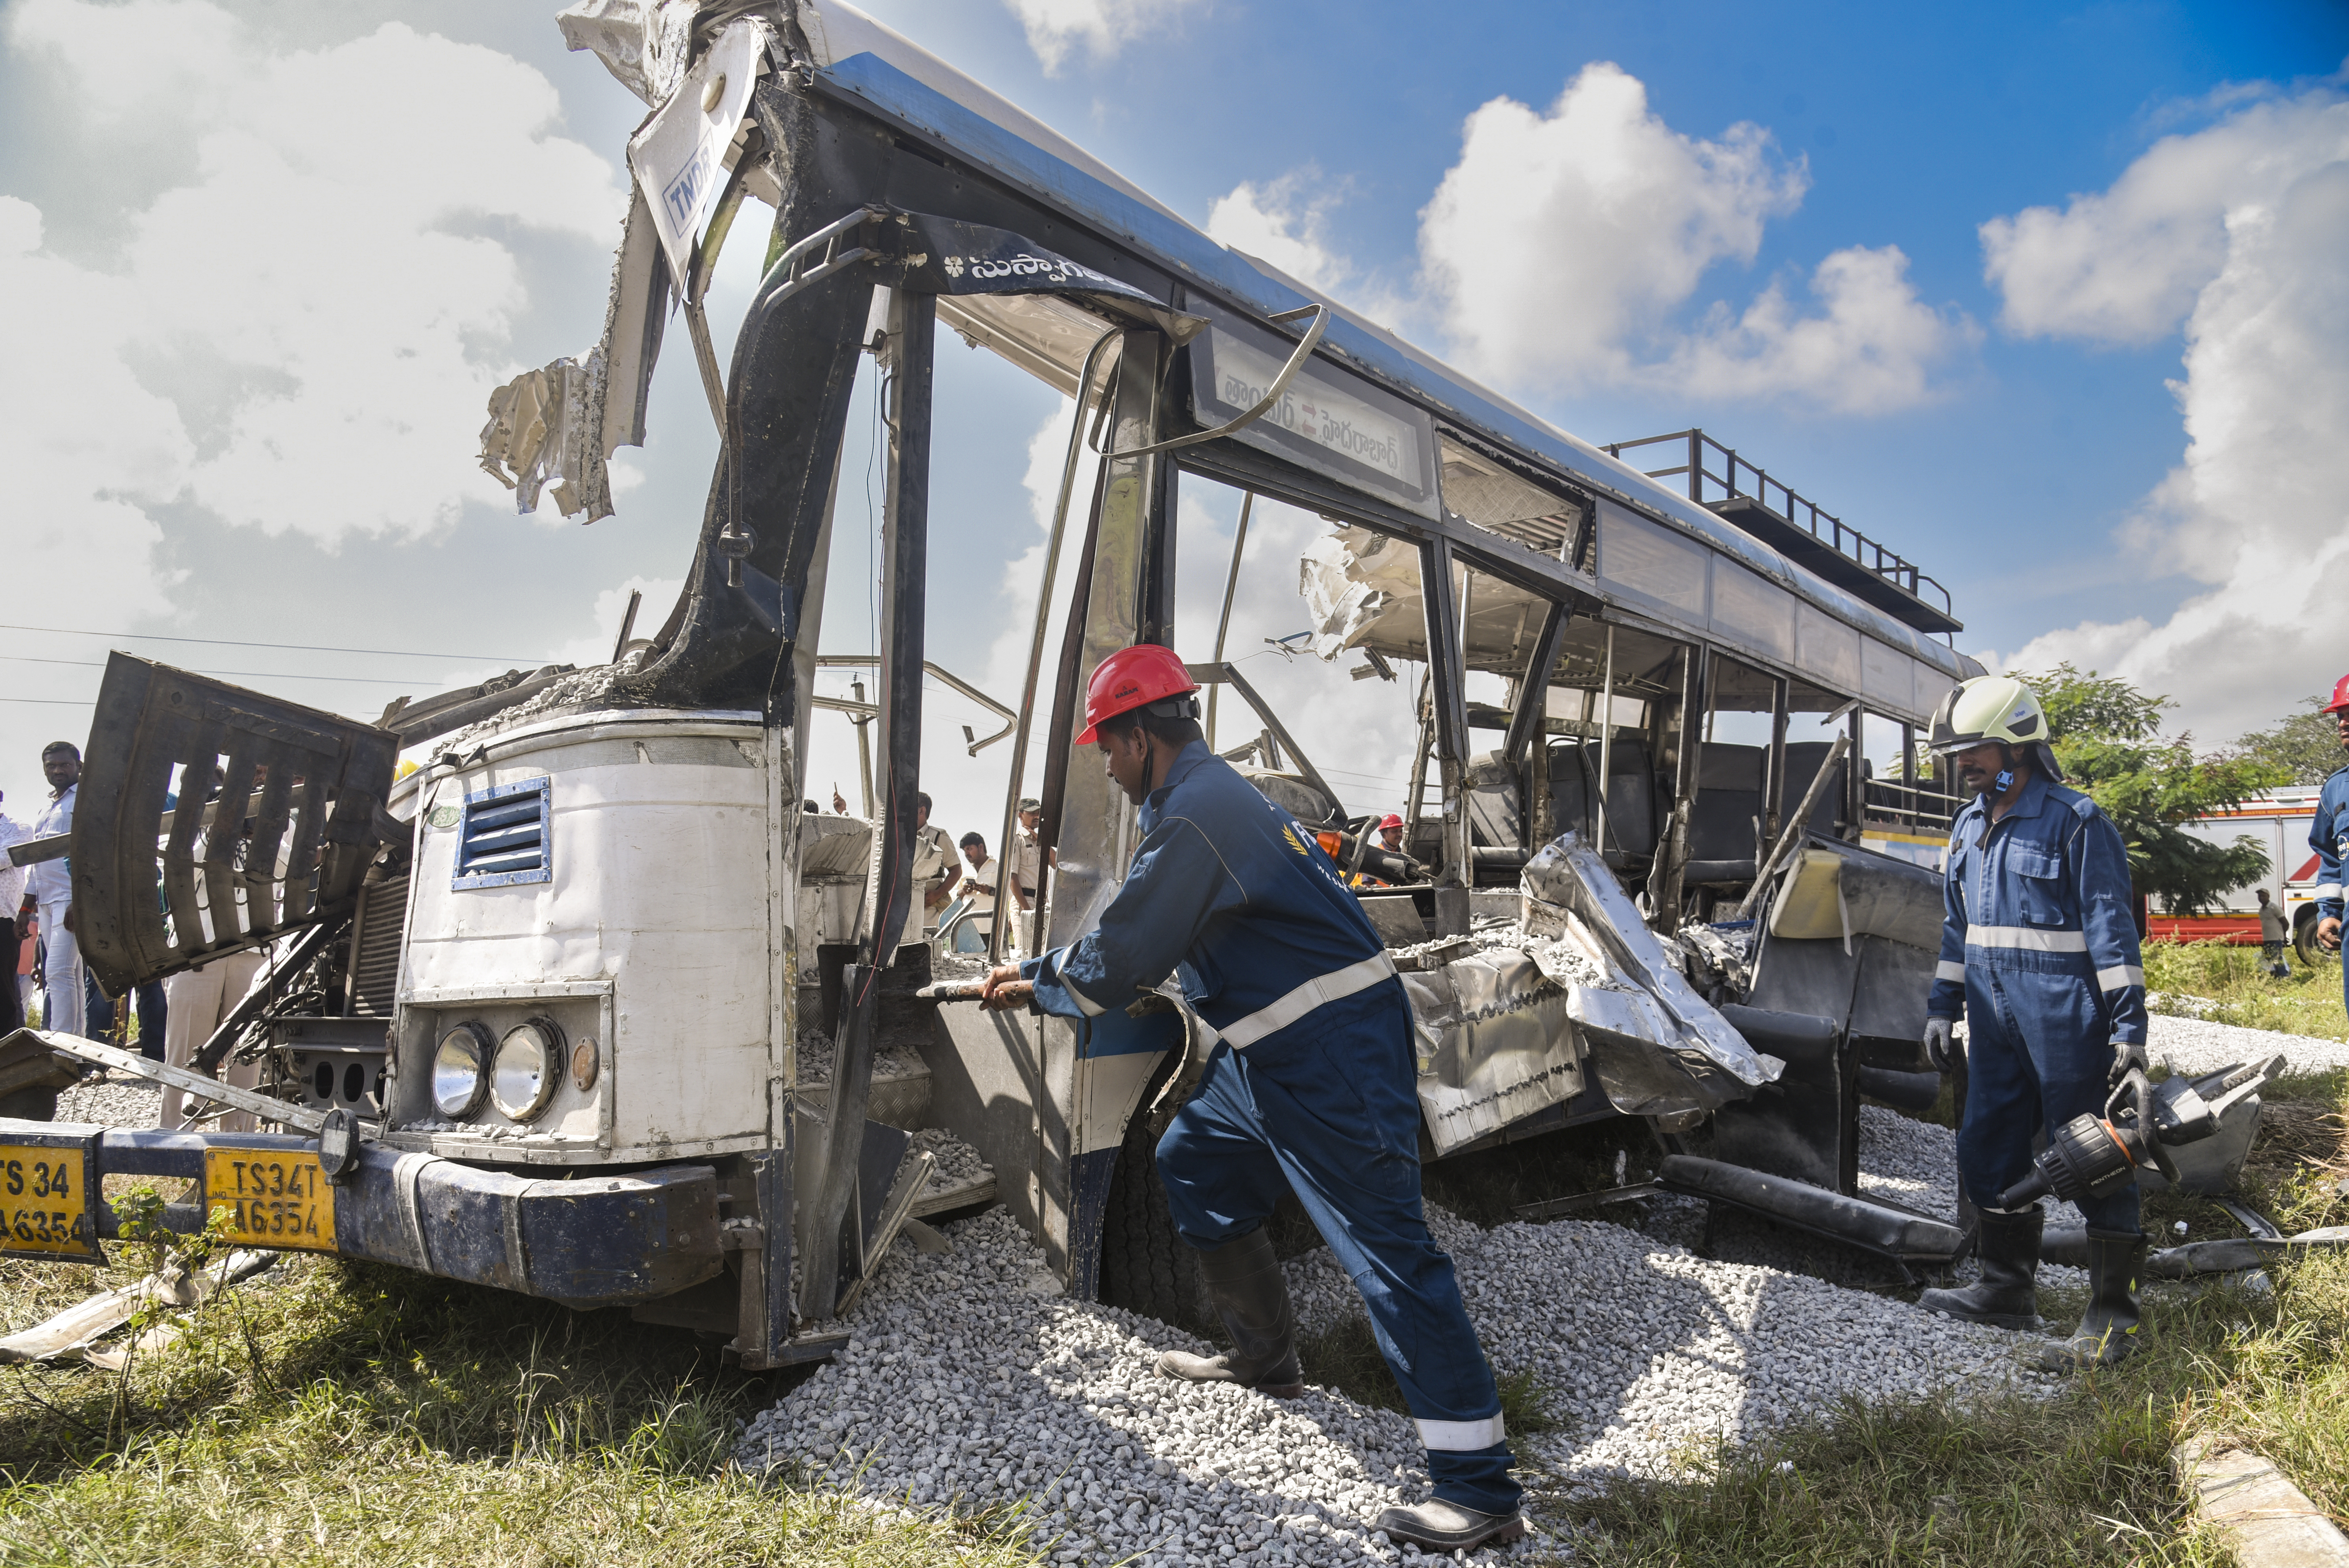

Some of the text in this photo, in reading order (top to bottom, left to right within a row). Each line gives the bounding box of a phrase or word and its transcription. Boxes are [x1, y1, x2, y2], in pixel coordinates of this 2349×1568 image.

[670, 146, 712, 221] TNDR
[1115, 687, 1138, 699] KARAM
[33, 1161, 69, 1199] 34
[232, 1160, 318, 1198] TS34T
[2091, 1166, 2126, 1186] PENTHEON
[235, 1199, 318, 1238] A6354
